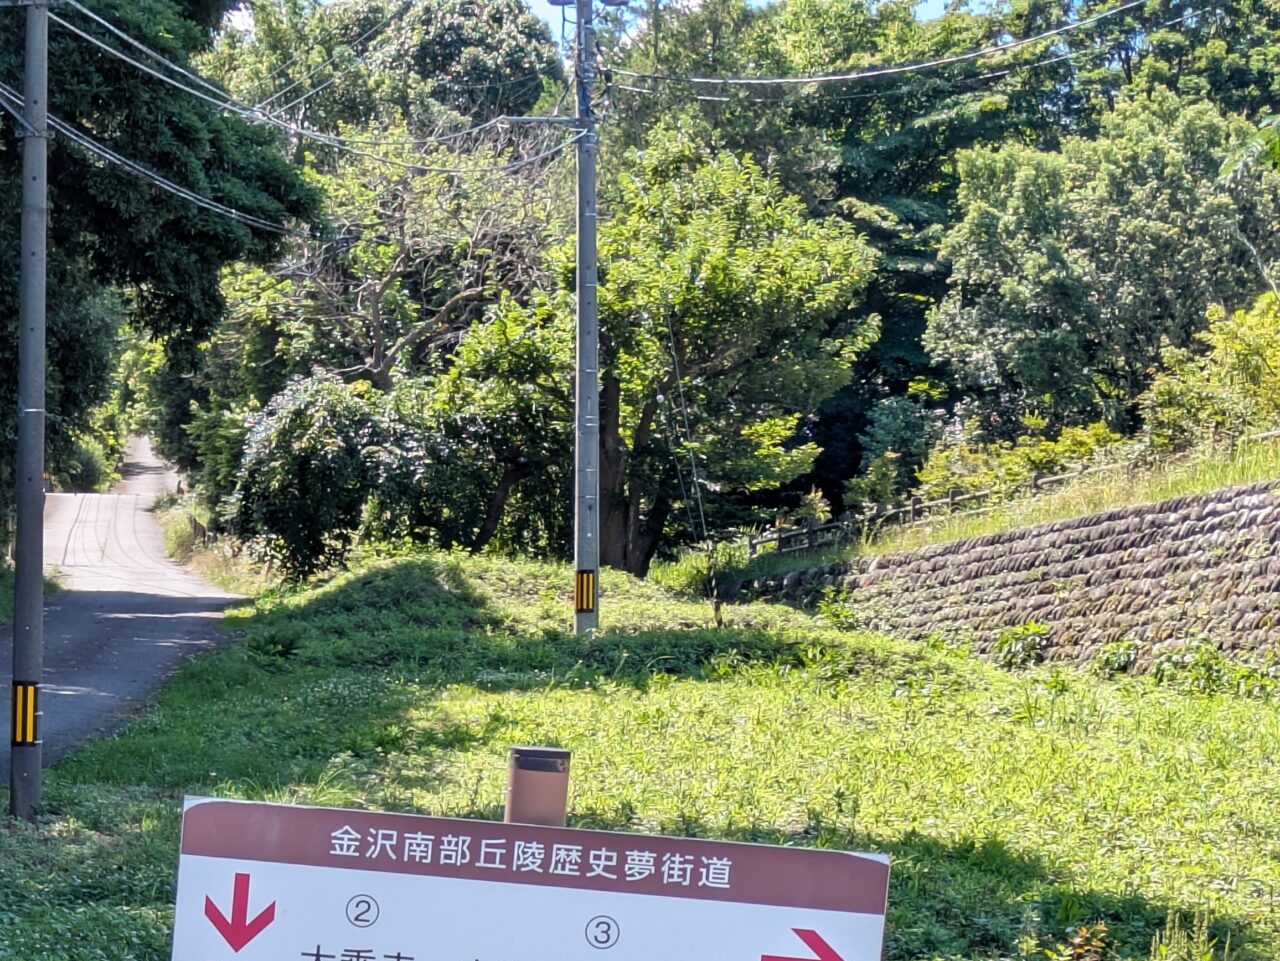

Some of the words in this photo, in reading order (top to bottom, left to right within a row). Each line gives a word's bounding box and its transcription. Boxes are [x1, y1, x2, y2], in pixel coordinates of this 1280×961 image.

[329, 826, 732, 888] 金沢南部丘陵歴史夢街道
